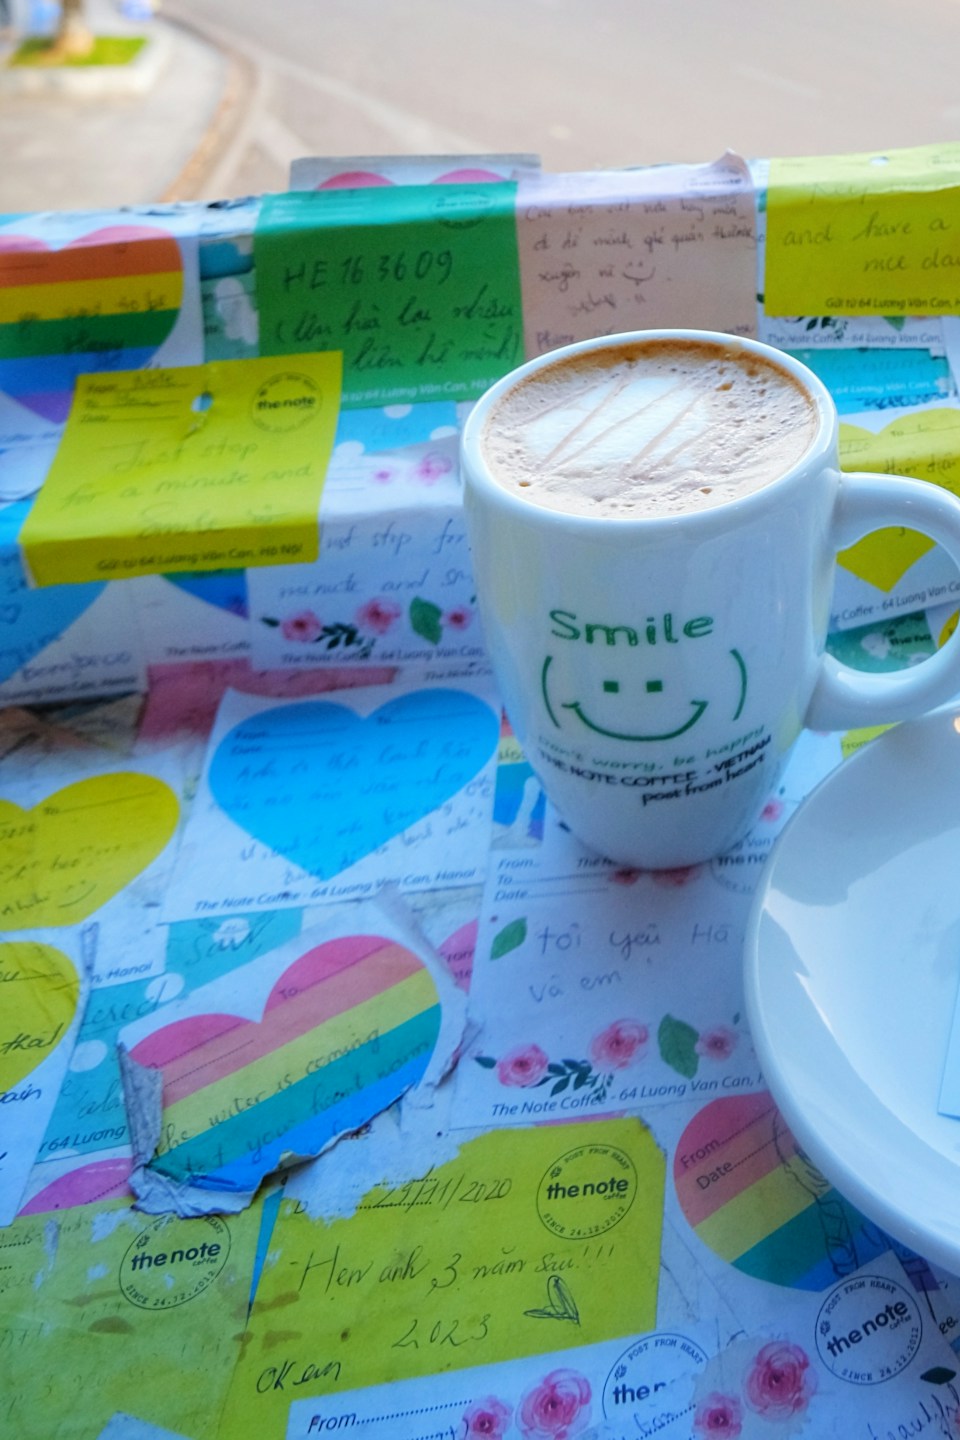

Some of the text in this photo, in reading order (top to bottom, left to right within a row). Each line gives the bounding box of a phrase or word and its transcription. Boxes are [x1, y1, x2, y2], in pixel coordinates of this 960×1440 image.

[784, 211, 950, 247] and have a
[859, 298, 870, 308] 64
[283, 394, 316, 410] note
[264, 464, 315, 481] and
[373, 532, 412, 557] stop
[842, 605, 873, 623] Coffee
[881, 598, 895, 610] 64
[897, 591, 927, 609] Luong
[929, 586, 947, 598] Van
[549, 609, 714, 647] Smile
[673, 755, 696, 766] be
[706, 725, 765, 759] happy
[540, 735, 772, 788] THE NOTE COFFEE VIETNAM
[642, 753, 766, 807] post from heart
[222, 897, 253, 909] Note
[311, 888, 326, 899] 64
[330, 882, 371, 899] Luong
[375, 878, 401, 891] Van
[403, 874, 431, 888] Can,
[435, 869, 475, 883] Hanoi
[499, 875, 512, 885] To
[494, 889, 528, 902] Date
[107, 961, 153, 979] Hanoi
[279, 987, 298, 1000] To
[305, 1027, 381, 1078] coming
[491, 1074, 756, 1117] The Note Coffee 64 Luong Van Can,
[50, 1136, 70, 1151] 64
[680, 1137, 721, 1170] From
[564, 1147, 630, 1170] POST FROM HEART
[546, 1177, 629, 1200] the note
[696, 1163, 734, 1191] Date
[543, 1213, 565, 1233] SINCE
[131, 1242, 221, 1271] the note
[474, 1246, 527, 1280] năm
[126, 1284, 149, 1305] SINCE
[825, 1280, 897, 1315] POST FROM HEART
[392, 1313, 492, 1350] 2023
[827, 1301, 908, 1357] the note
[628, 1338, 704, 1364] POST FROM HEART
[841, 1368, 873, 1381] SINCE
[613, 1383, 650, 1405] the
[308, 1412, 357, 1434] From
